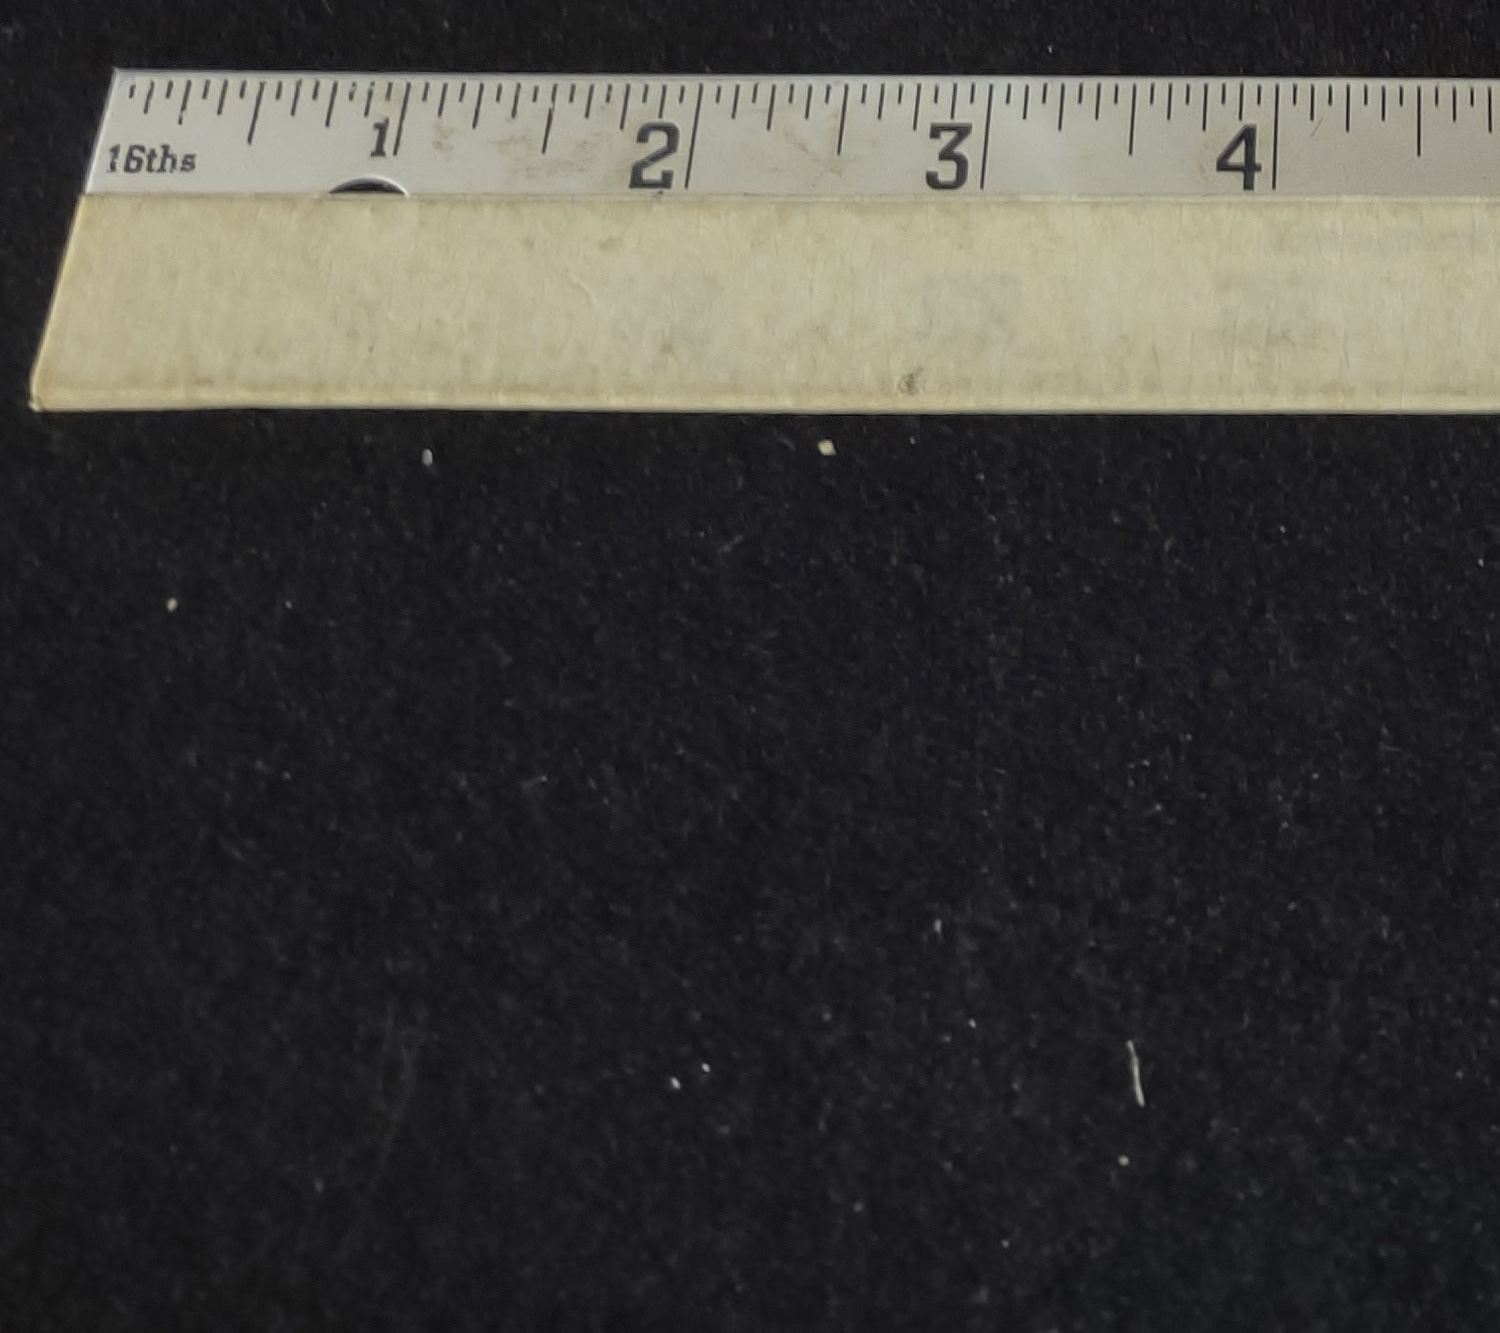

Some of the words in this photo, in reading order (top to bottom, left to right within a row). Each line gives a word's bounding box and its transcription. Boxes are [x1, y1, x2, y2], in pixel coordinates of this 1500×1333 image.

[106, 144, 196, 175] 16ths
[371, 120, 389, 157] 1
[629, 122, 678, 190] 2
[925, 122, 972, 190] 3
[1215, 124, 1261, 190] 4
